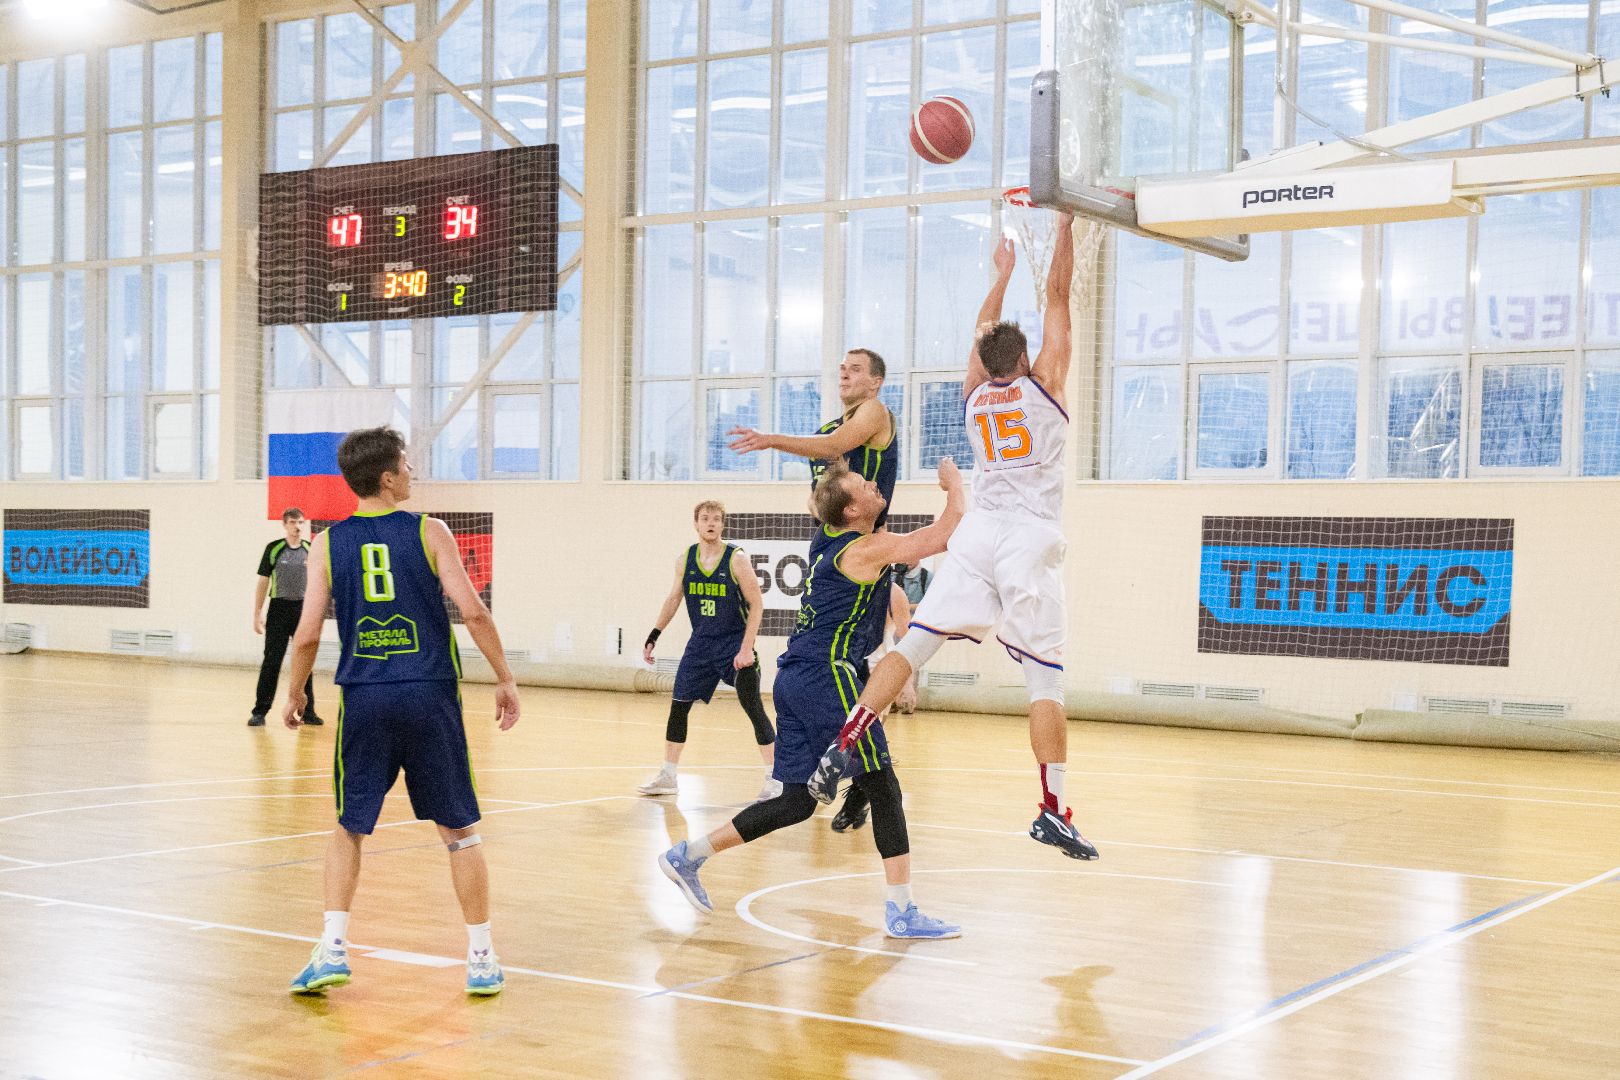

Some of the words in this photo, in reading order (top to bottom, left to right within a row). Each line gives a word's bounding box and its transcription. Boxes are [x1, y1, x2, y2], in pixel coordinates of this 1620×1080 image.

[331, 214, 363, 246] 47
[394, 215, 406, 237] 3
[445, 206, 478, 240] 34
[383, 270, 428, 299] 3:40
[453, 285, 466, 306] 2
[341, 293, 347, 311] 1
[973, 408, 1033, 462] 15
[10, 540, 140, 576] ВОЛЕЙБОЛ
[361, 543, 395, 602] 8
[1221, 560, 1487, 617] ТЕННИС
[359, 628, 408, 640] МЕТАЛЛ
[360, 637, 412, 649] ПРОФИЛЬ
